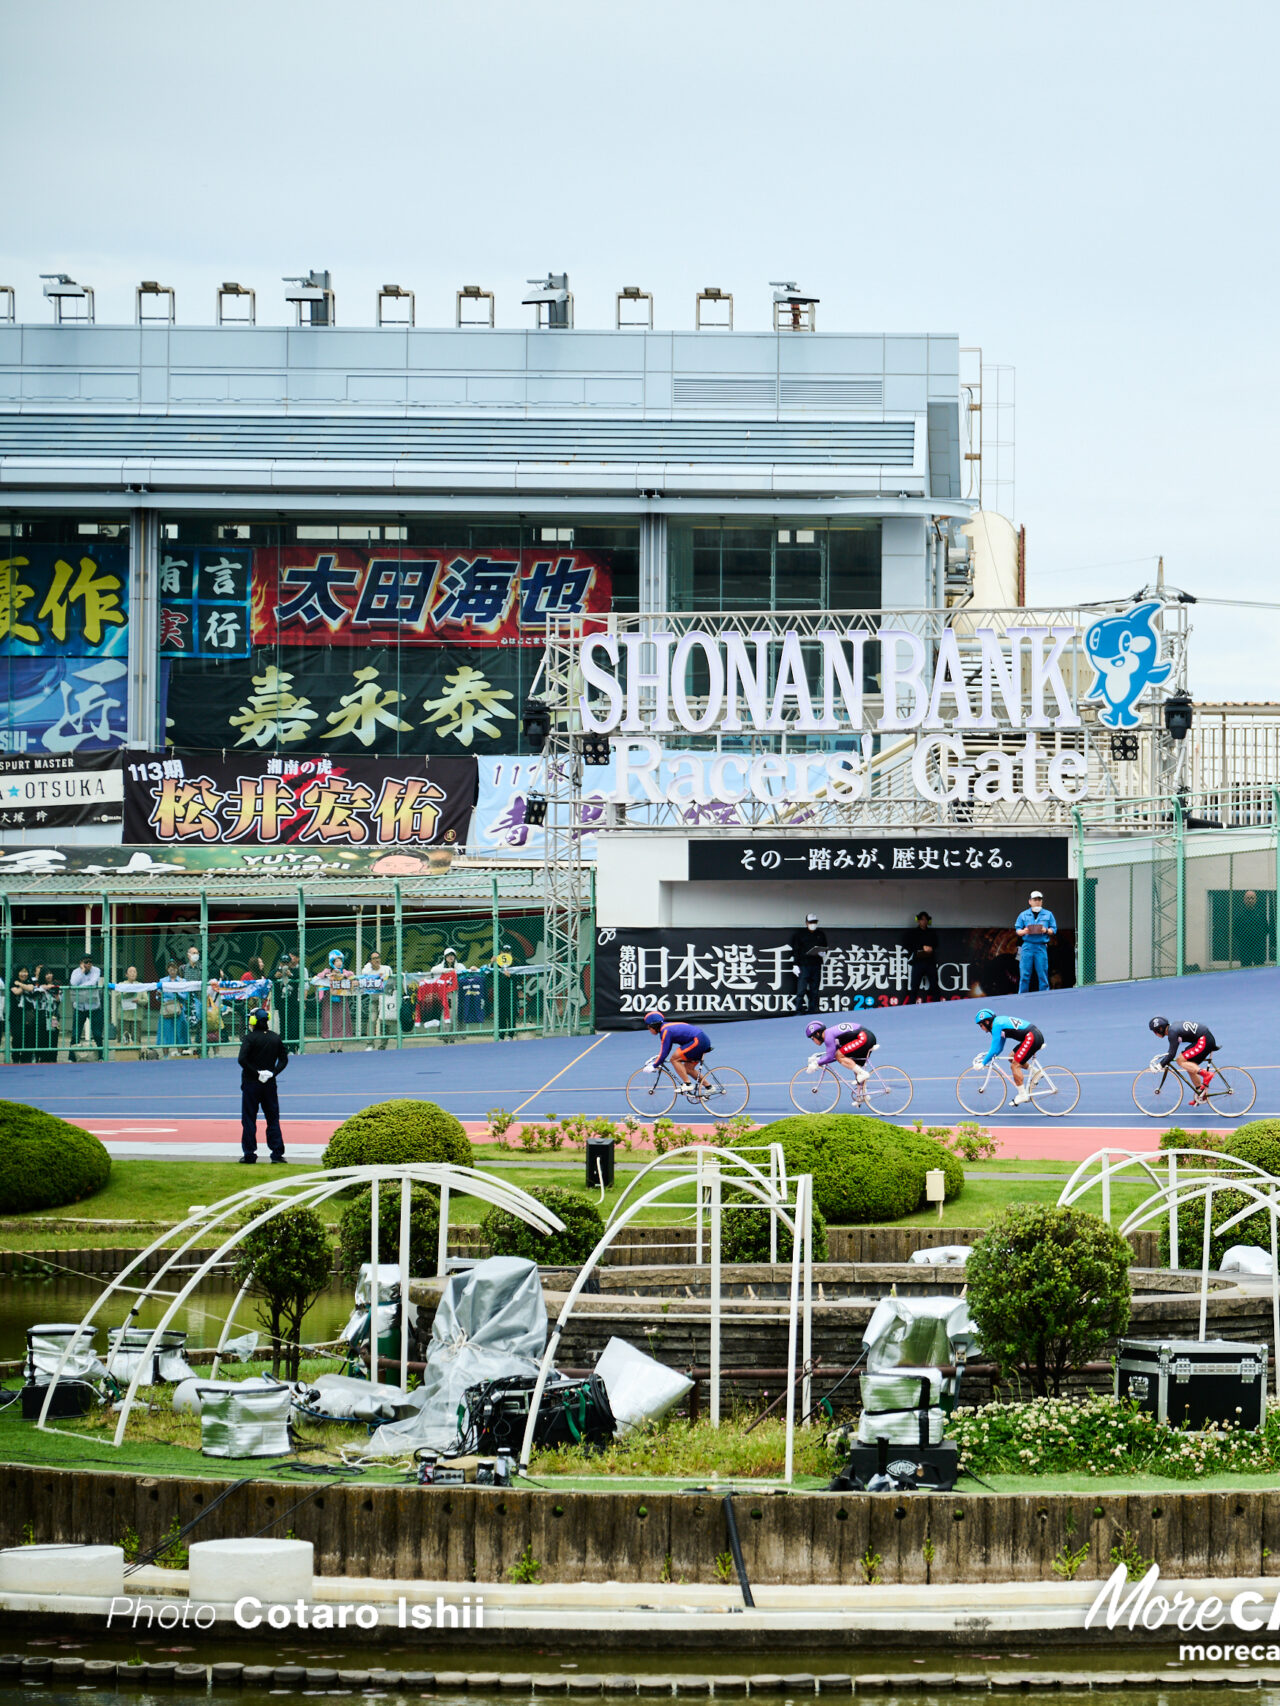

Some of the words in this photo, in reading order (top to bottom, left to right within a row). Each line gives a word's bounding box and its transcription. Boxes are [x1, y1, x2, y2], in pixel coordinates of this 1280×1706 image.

[273, 554, 596, 630] 太田海也
[579, 630, 869, 733] SHONAN
[877, 627, 1082, 729] BANK
[0, 761, 31, 771] SPURT
[34, 757, 74, 769] MASTER
[128, 759, 185, 781] 113期
[267, 758, 333, 775] 湘南の虎
[912, 732, 1089, 802] Gate
[24, 778, 105, 800] OTSUKA
[149, 775, 448, 844] 松井宏佑
[242, 853, 325, 866] YUYA
[740, 846, 1014, 871] その一踏みが、歴史になる。
[619, 994, 672, 1012] 2026
[1009, 1016, 1023, 1030] 4
[1182, 1020, 1198, 1034] 2
